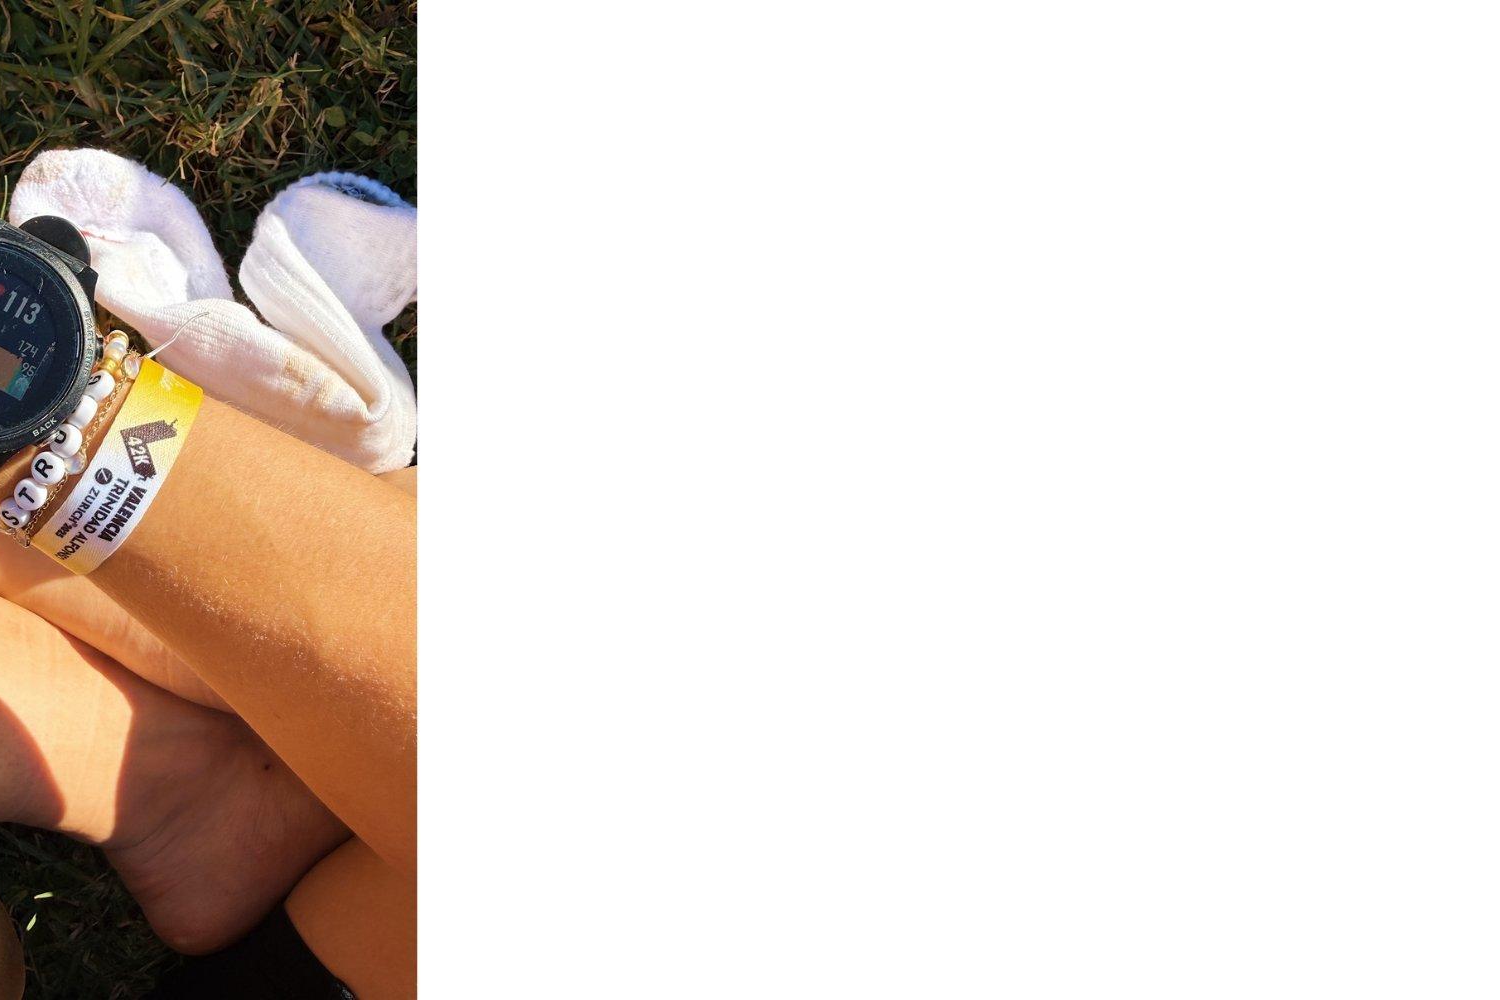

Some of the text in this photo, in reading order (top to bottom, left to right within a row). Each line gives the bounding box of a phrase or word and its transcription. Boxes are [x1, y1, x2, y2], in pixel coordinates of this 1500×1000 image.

[3, 290, 41, 324] 113
[18, 340, 39, 358] 174
[22, 362, 36, 377] 95
[32, 416, 57, 437] BACK
[128, 436, 151, 466] 42K
[83, 478, 130, 534] TRINIDAD
[98, 485, 148, 542] VALENCIA
